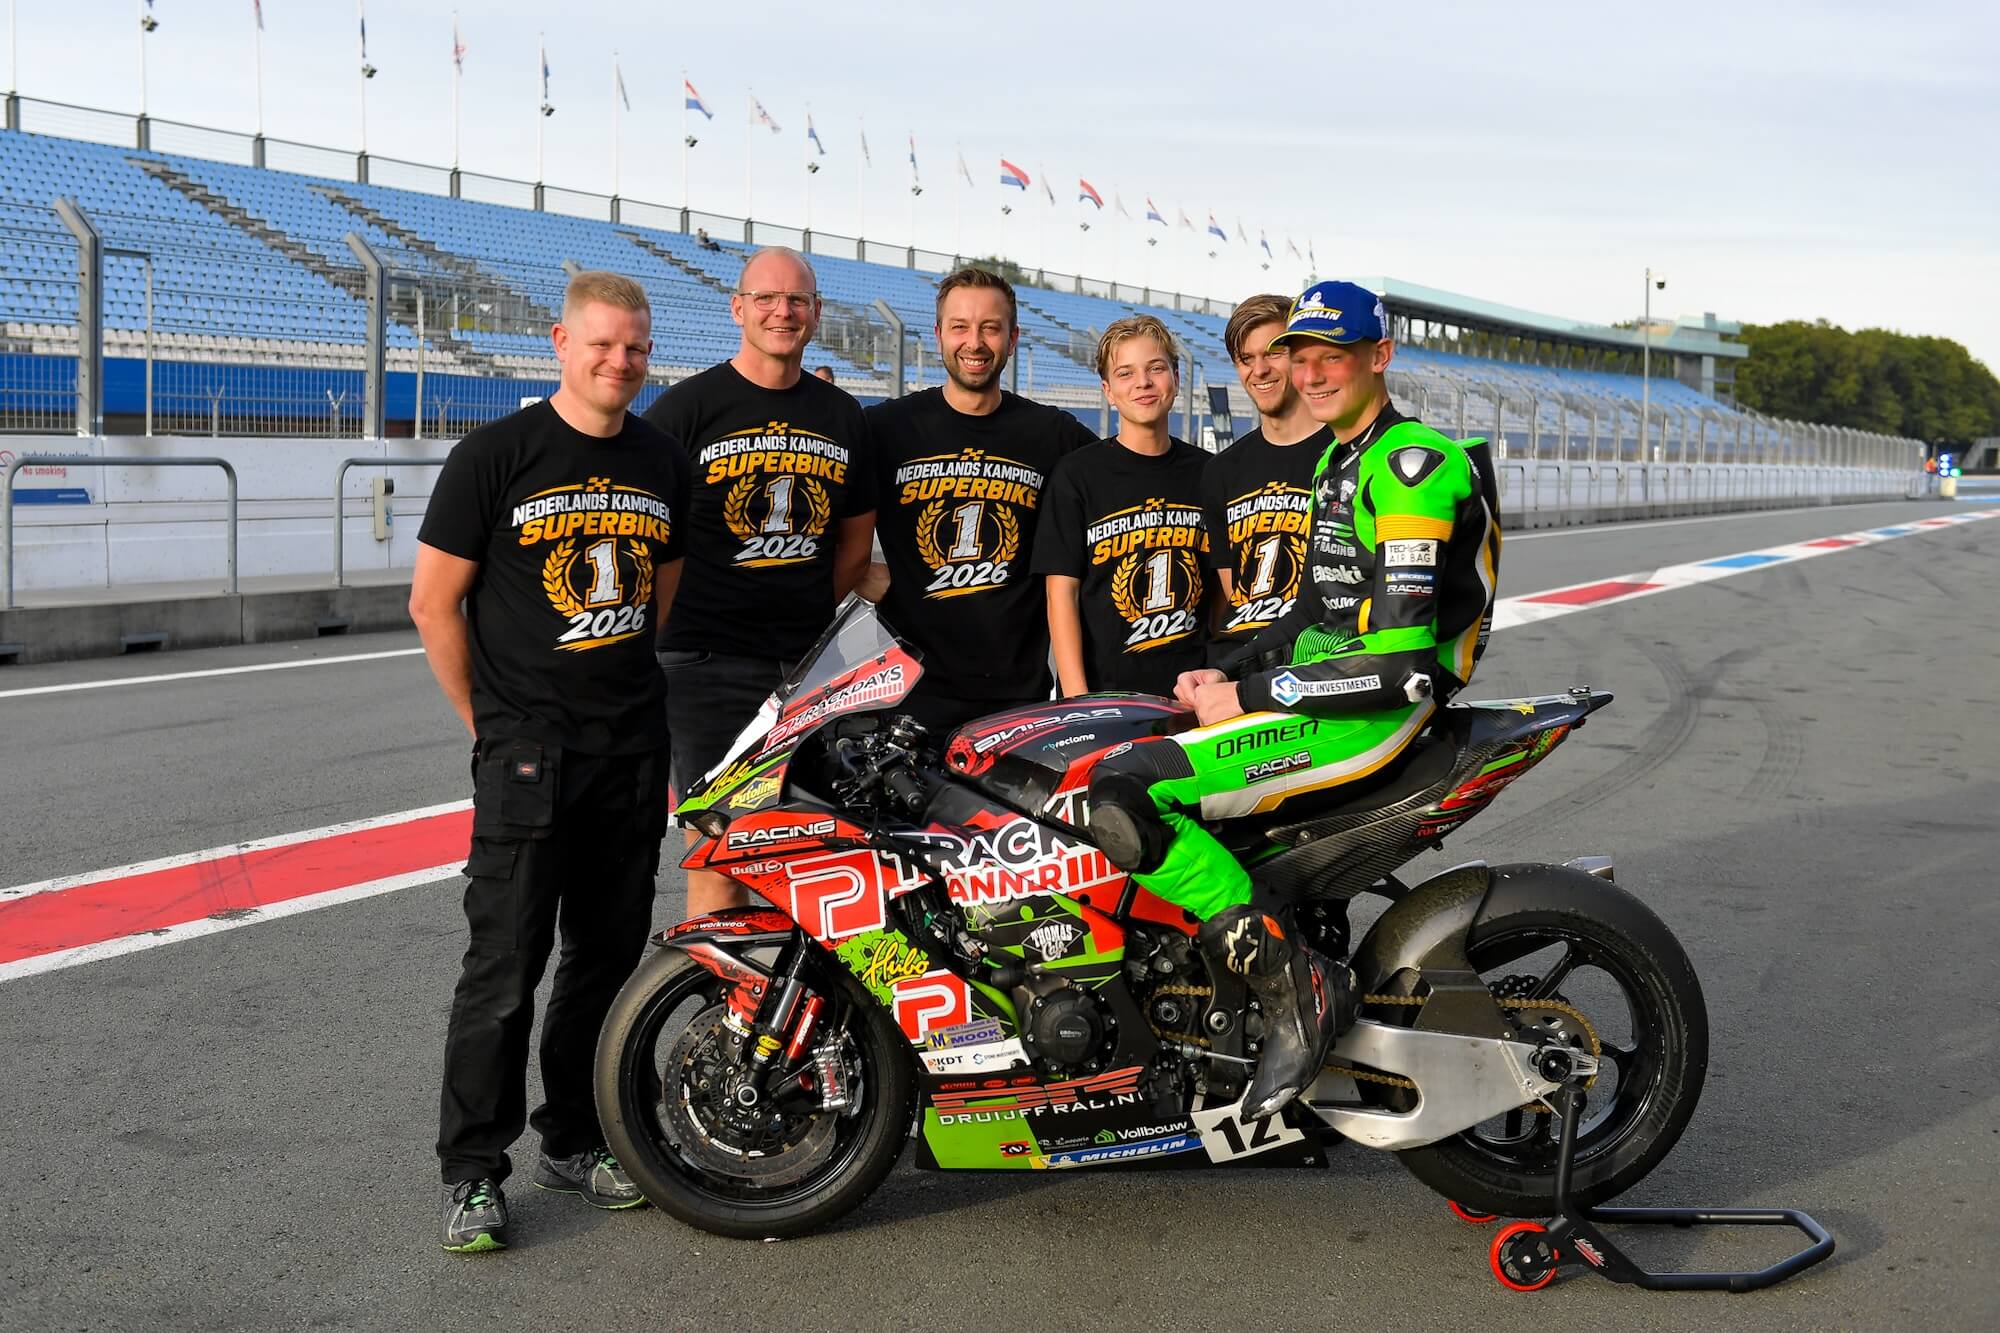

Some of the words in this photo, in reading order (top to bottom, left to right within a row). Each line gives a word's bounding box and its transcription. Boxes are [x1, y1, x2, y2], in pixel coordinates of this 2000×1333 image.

[700, 435, 787, 465] NEDERLANDS
[789, 436, 849, 464] KAMPIOEN
[35, 466, 67, 478] smoking
[705, 451, 847, 486] SUPERBIKE
[896, 462, 981, 485] NEDERLANDS
[983, 463, 1044, 490] KAMPIOEN
[762, 475, 795, 534] 1
[899, 477, 1038, 510] SUPERBIKE
[513, 494, 609, 527] NEDERLANDS
[611, 493, 671, 524] KAMPIOEN
[1227, 495, 1286, 524] DERLANDS
[519, 511, 670, 546] SUPERBIKE
[947, 501, 985, 563] 1
[1087, 511, 1163, 547] NEDERLANDS
[1166, 510, 1206, 531] KAMP
[733, 534, 820, 561] 2026
[1410, 553, 1431, 563] BAG
[585, 538, 623, 609] 1
[924, 561, 1009, 592] 2026
[1143, 549, 1176, 616] 1
[1250, 534, 1281, 601] 1
[556, 604, 646, 643] 2026
[1124, 609, 1197, 646] 2026
[791, 664, 903, 728] TRACKDAYS
[1289, 683, 1315, 693] STONE
[1317, 678, 1378, 693] INVESTMENTS
[1245, 752, 1310, 778] RACING
[728, 820, 835, 845] RACING
[1030, 924, 1073, 947] THOMAS
[862, 939, 930, 988] Hubo
[951, 1029, 999, 1044] MOOK
[937, 1055, 963, 1066] KDT
[1117, 1121, 1188, 1141] Vollbouw
[1080, 1138, 1187, 1163] MICHELIN
